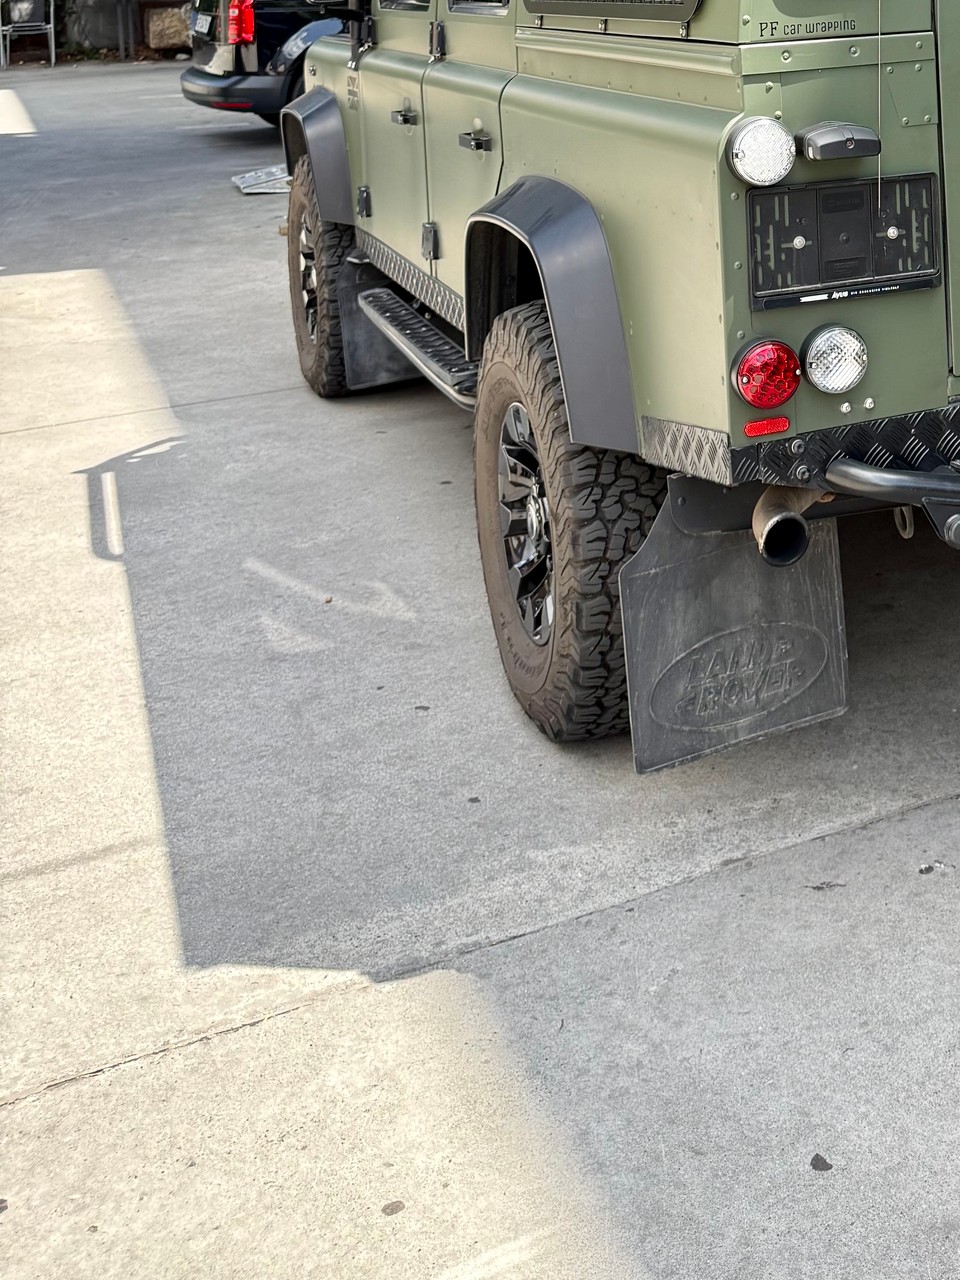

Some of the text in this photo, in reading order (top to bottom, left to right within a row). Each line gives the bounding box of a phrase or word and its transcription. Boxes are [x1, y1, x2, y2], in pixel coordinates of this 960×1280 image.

[759, 19, 856, 37] PF car wrapping
